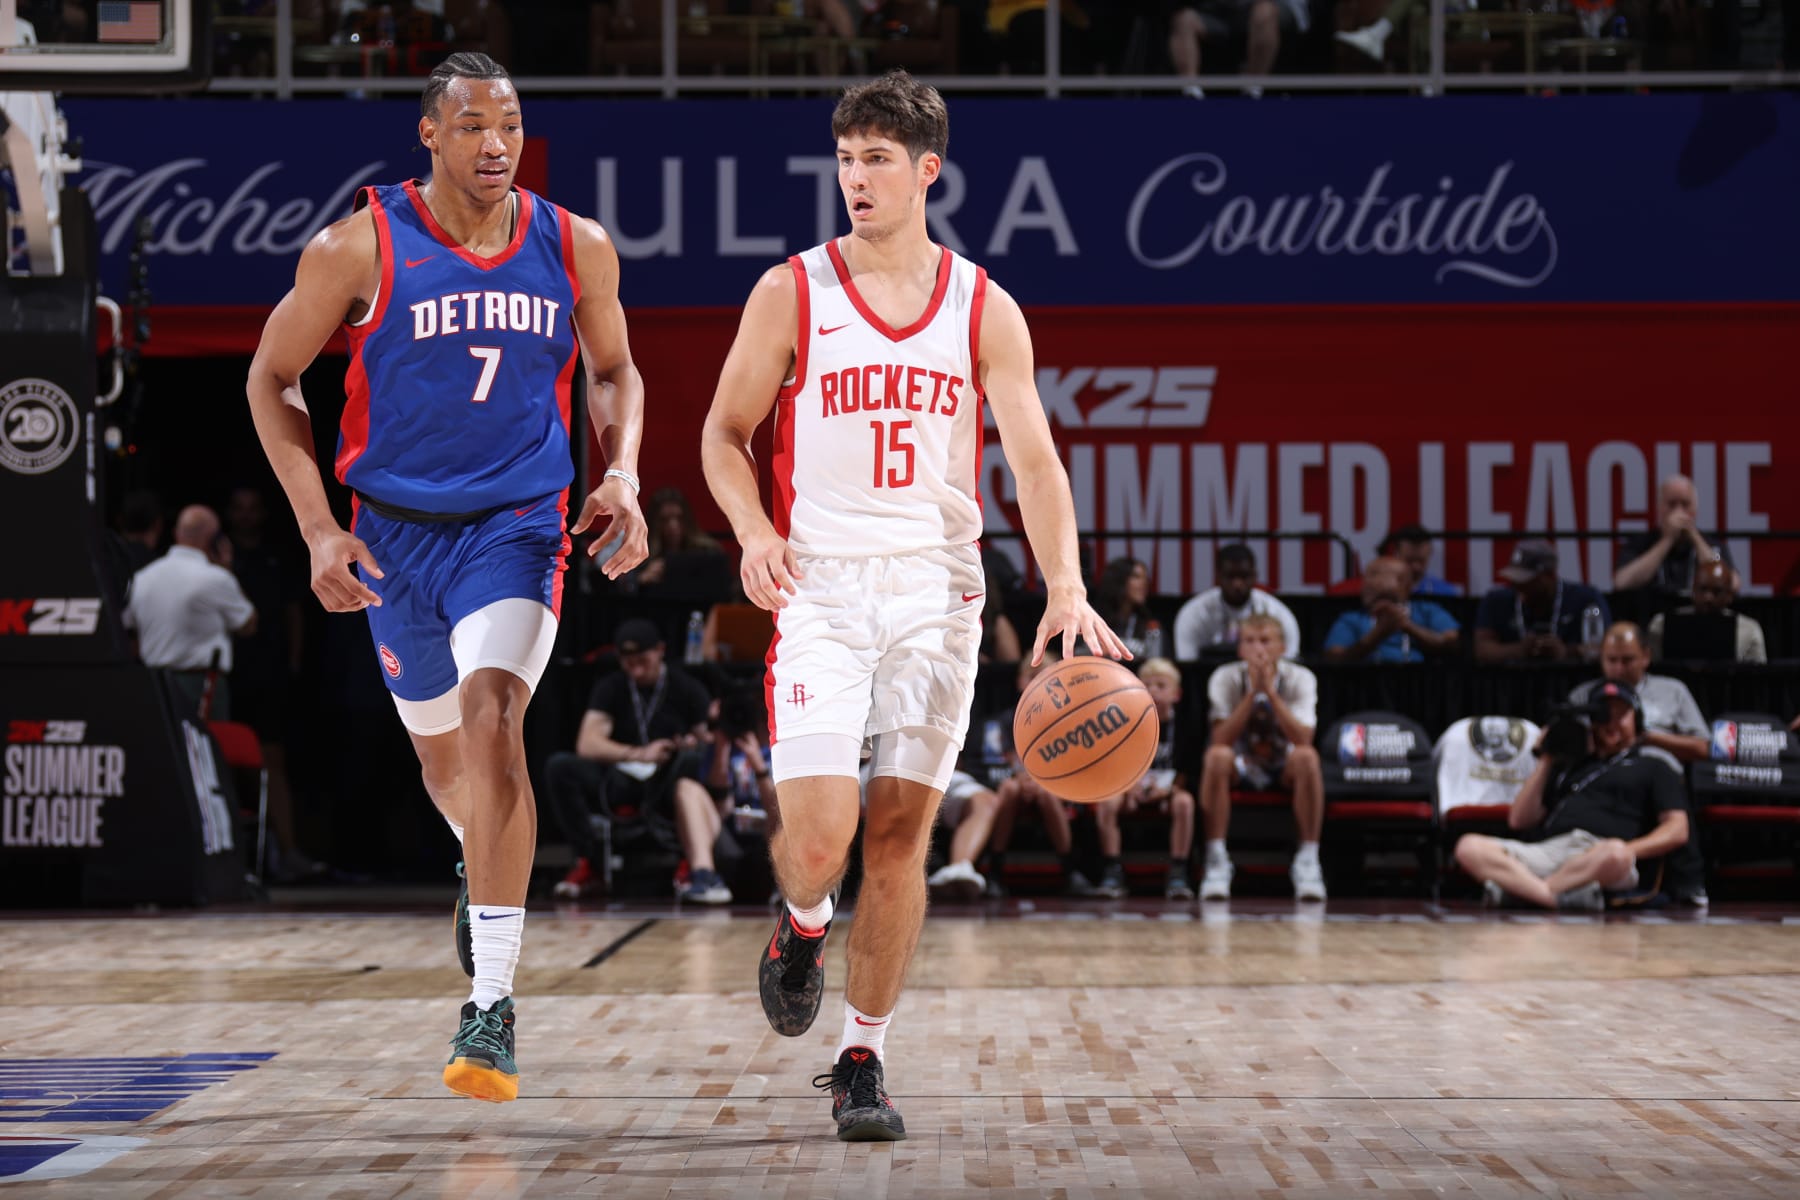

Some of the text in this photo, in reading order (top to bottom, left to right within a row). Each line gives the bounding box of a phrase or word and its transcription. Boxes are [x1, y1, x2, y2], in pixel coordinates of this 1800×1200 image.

[80, 158, 432, 254] Michel
[1126, 152, 1558, 287] Courtside
[409, 290, 561, 341] DETROIT
[468, 345, 503, 402] 7
[820, 364, 964, 418] ROCKETS
[983, 366, 1217, 428] K25
[870, 420, 915, 488] 15
[8, 720, 86, 743] 2K25
[1038, 704, 1129, 762] Wilson
[4, 745, 125, 796] SUMMER
[3, 797, 103, 847] LEAGUE
